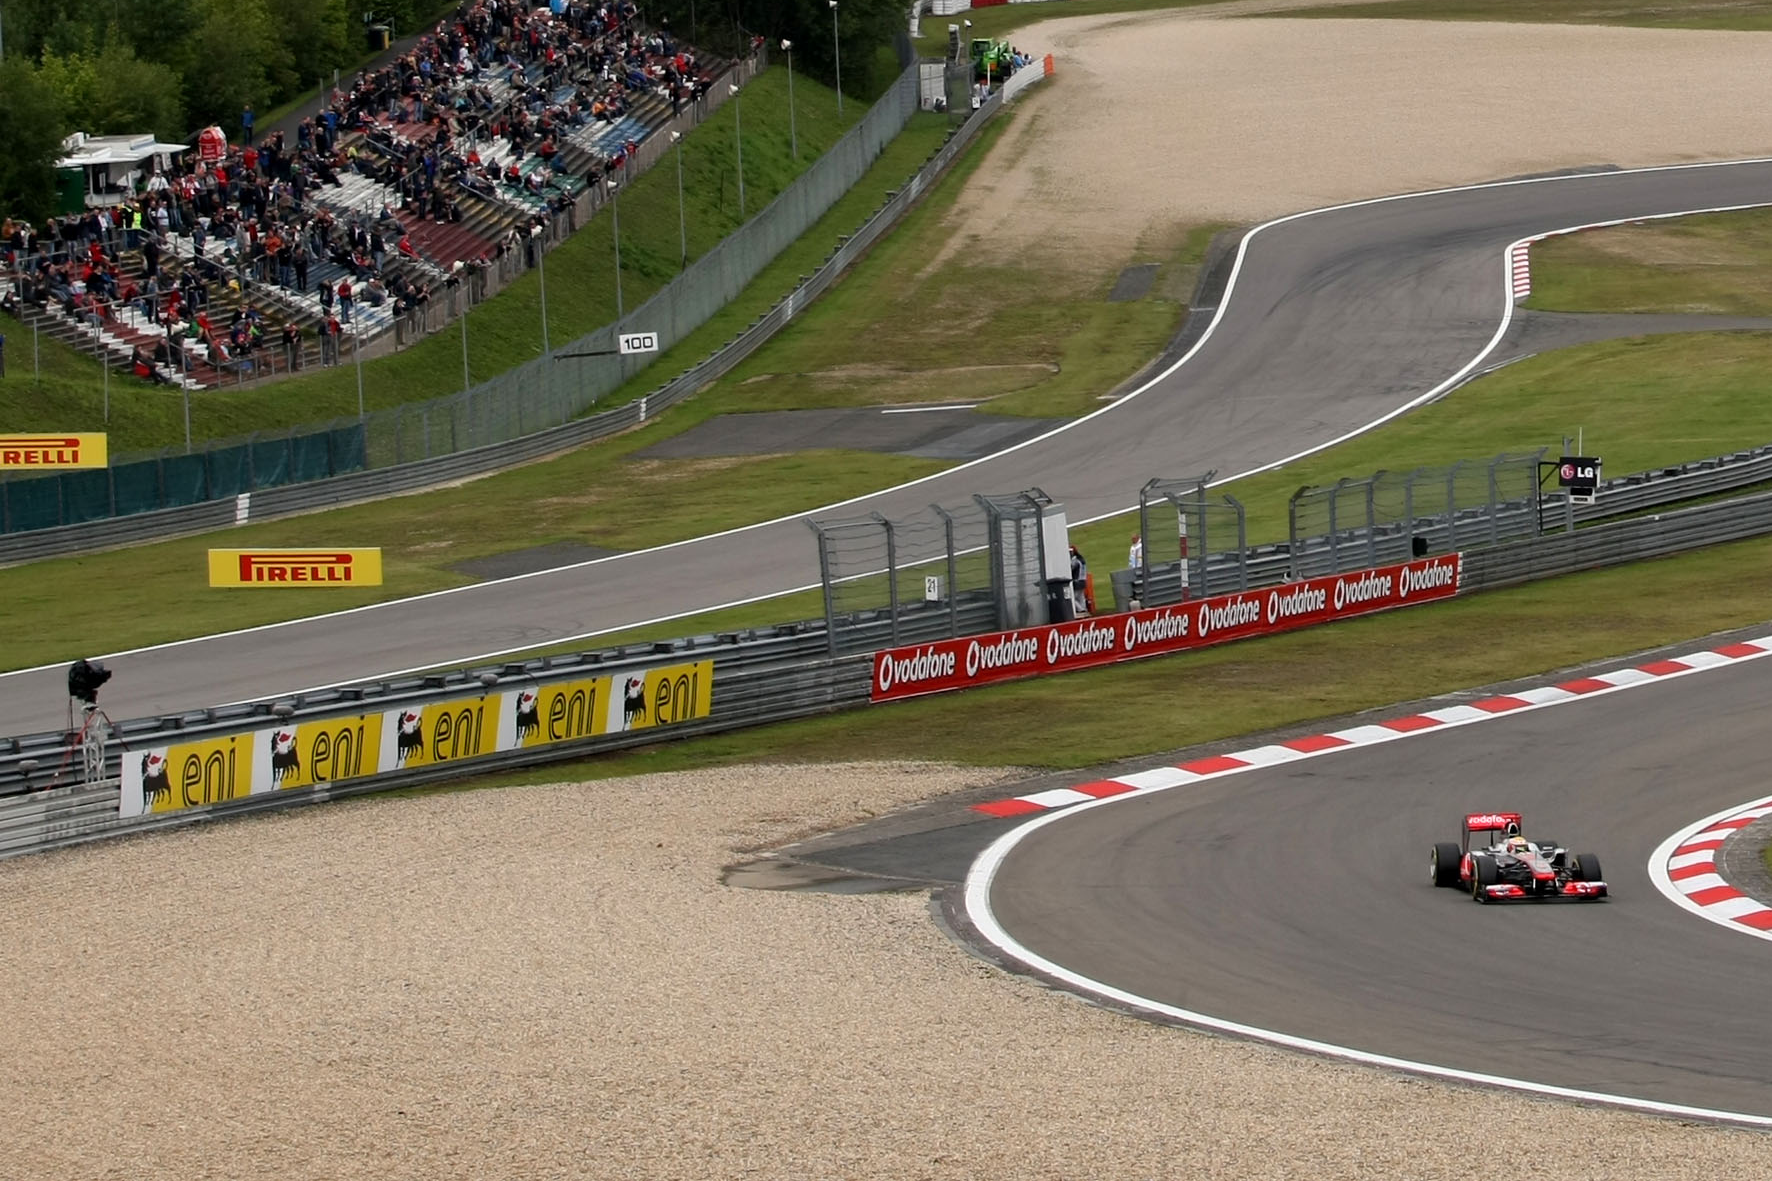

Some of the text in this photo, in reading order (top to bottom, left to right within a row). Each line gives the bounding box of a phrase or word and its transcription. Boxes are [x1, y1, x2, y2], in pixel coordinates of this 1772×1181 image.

[625, 336, 653, 350] 100
[1577, 467, 1594, 478] LG
[239, 553, 353, 582] PIRELLI
[893, 561, 1453, 684] vodafone vodafone vodafone vodafone vodafone vodafone vodafone vodafone
[182, 662, 699, 807] eni eni eni eni eni
[1468, 814, 1512, 824] vodafo
